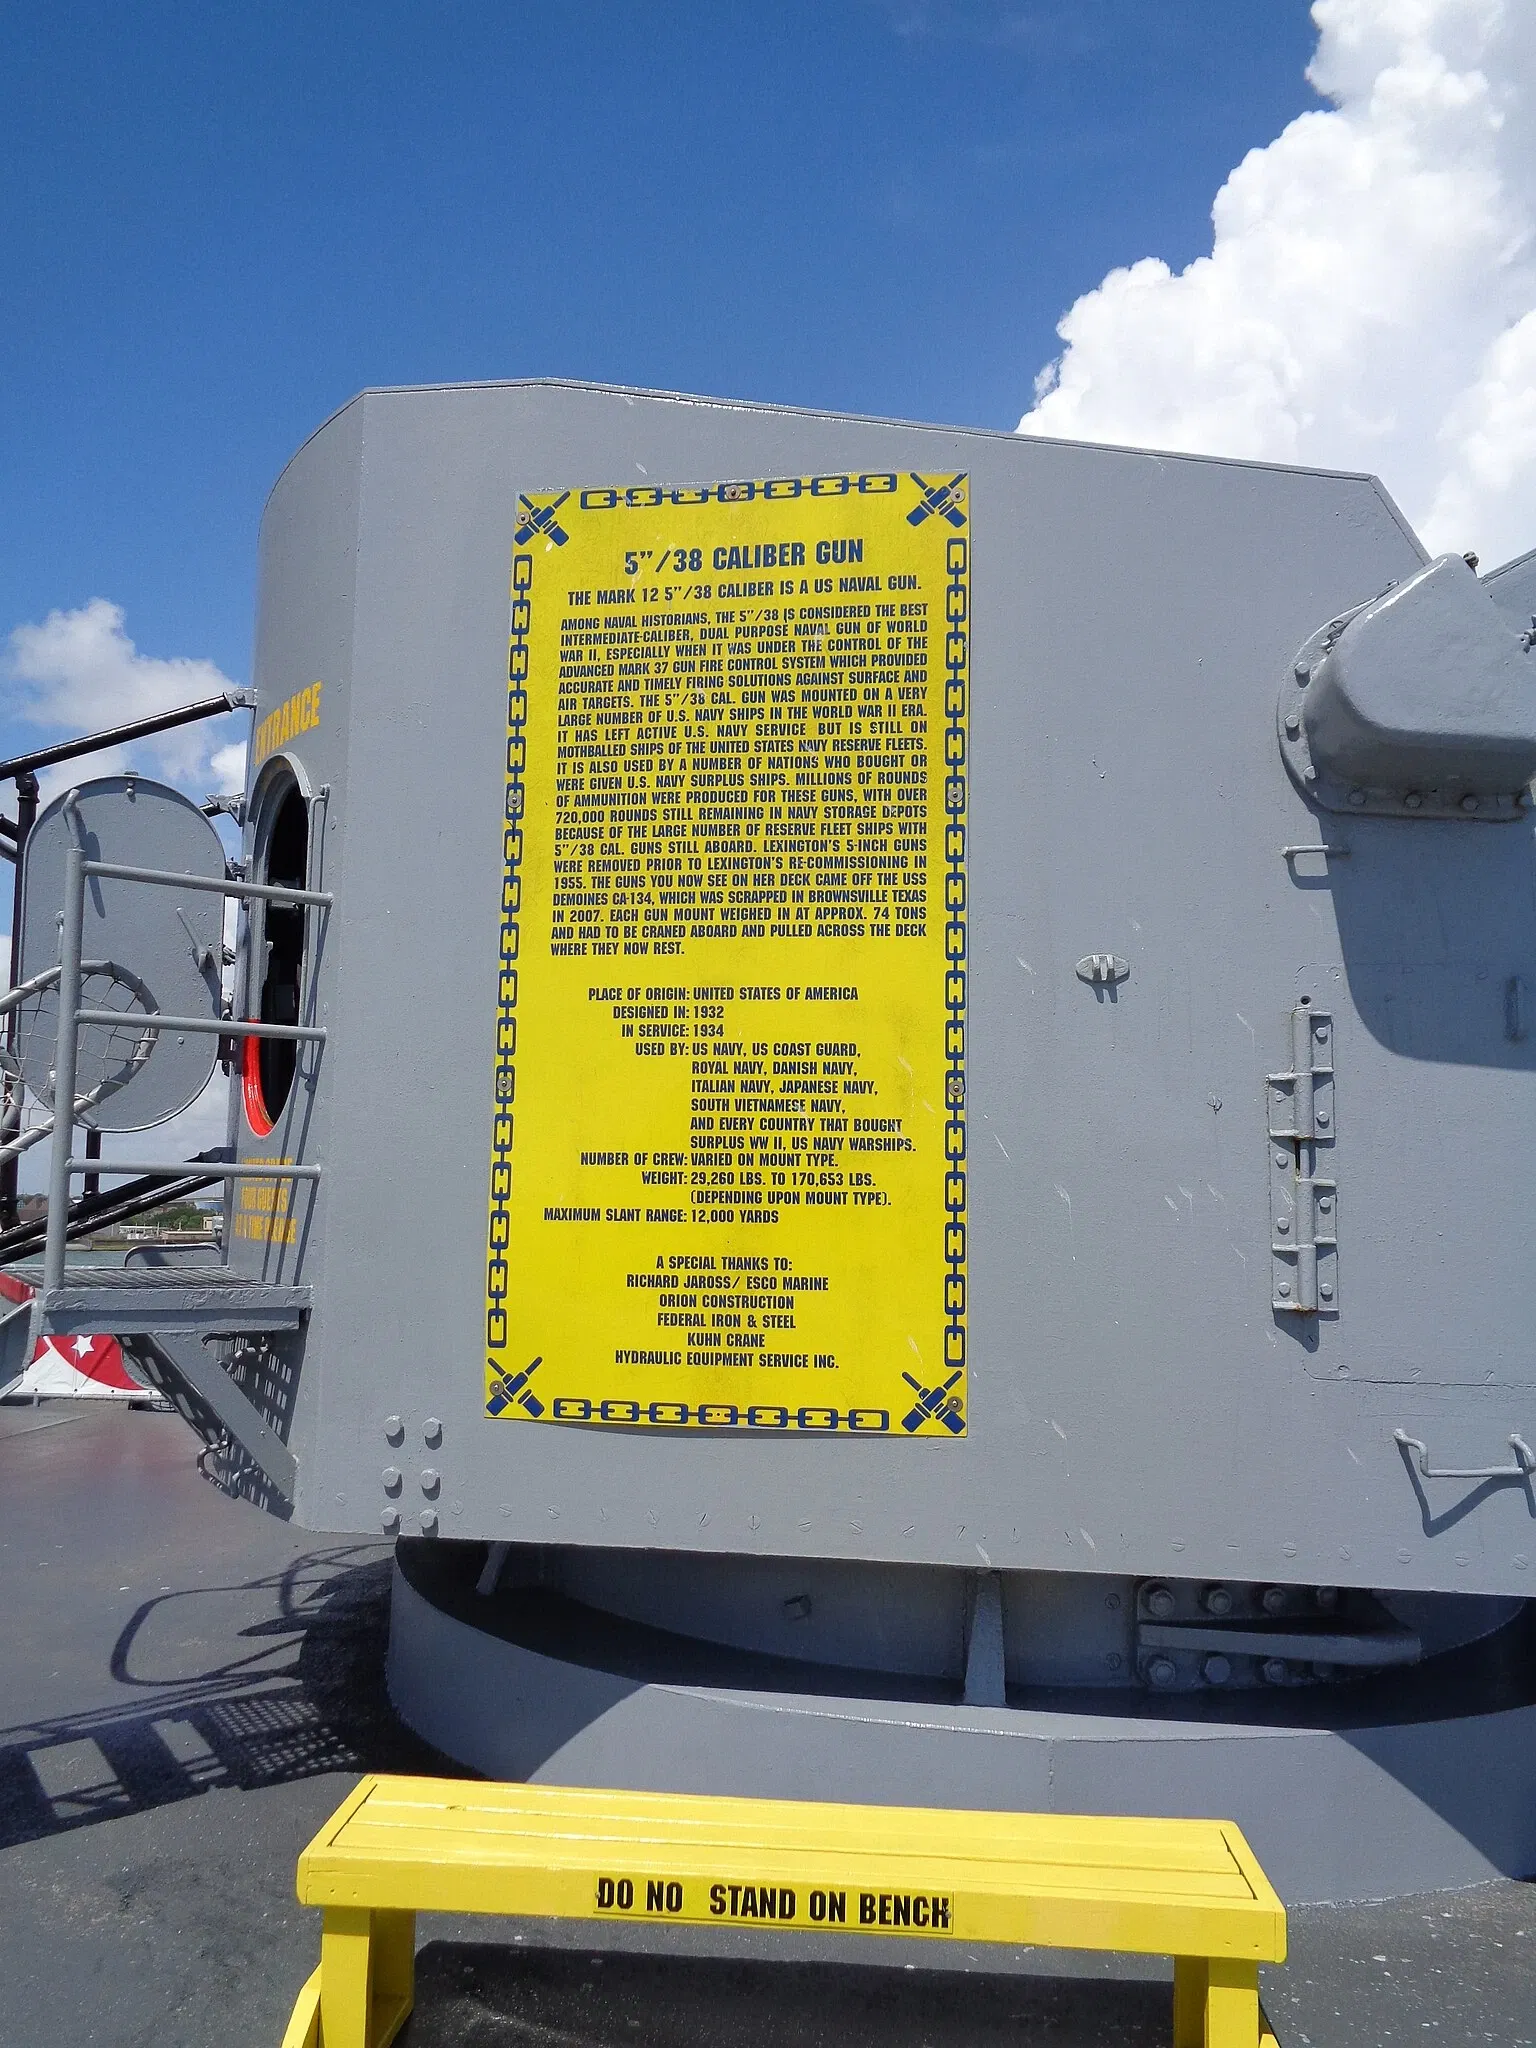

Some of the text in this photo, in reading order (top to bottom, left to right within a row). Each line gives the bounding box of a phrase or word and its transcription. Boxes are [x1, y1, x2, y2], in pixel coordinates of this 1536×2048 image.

[712, 542, 805, 570] CALIBER
[815, 538, 863, 564] GUN
[567, 590, 591, 605] THE
[596, 588, 635, 604] MARK
[642, 587, 658, 602] 12
[717, 581, 773, 598] CALIBER
[779, 579, 793, 595] IS
[799, 579, 808, 594] A
[814, 578, 833, 593] US
[839, 575, 882, 592] NAVAL
[887, 574, 921, 590] GUN.
[560, 619, 927, 645] INTERMEDIATE-CALIBER, DUAL PURPOSE NAVAL GUN OF WORLD
[558, 652, 927, 678] ADVANCED MARK 37 GUN FIRE CONTROL SYSTEM WHICH PROVIDED
[255, 680, 322, 767] ENTRANCE
[555, 770, 927, 791] WERE GIVEN U.S. NAVY SURPLUS SHIPS. MILLIONS OF ROUNDS
[555, 804, 927, 825] 720,000 ROUNDS STILL REMAINING IN NAVY STORAGE DEPOTS
[552, 889, 926, 906] DEMOINES CA-134, WHICH WAS SCRAPPED IN BROWNSVILLE TEXAS
[588, 986, 858, 1000] PLACE OF ORIGIN: UNITED STATES OF AMERICA
[612, 1005, 724, 1019] DESIGNED IN: 1932
[621, 1023, 724, 1037] IN SERVICE: 1934
[635, 1042, 860, 1057] USED BY: US NAVY, US COAST GUARD,
[691, 1060, 857, 1076] ROYAL NAVY, DANISH NAVY,
[691, 1079, 877, 1095] ITALIAN NAVY, JAPANESE NAVY,
[690, 1097, 845, 1114] SOUTH VIETNAMESE NAVY,
[689, 1116, 902, 1132] AND EVERY COUNTRY THAT BOUGHT
[690, 1135, 916, 1151] SURPLUS WW II, US NAVY WARSHIPS.
[580, 1151, 838, 1166] NUMBER OF CREW: VARIED ON MOUNT TYPE.
[641, 1170, 876, 1187] WEIGHT: 29,260 LBS. TO 170,653 LBS.
[690, 1189, 891, 1205] (DEPENDING UPON MOUNT TYPE).
[543, 1207, 778, 1223] MAXIMUM SLANT RANGE: 12,000 YARDS
[655, 1255, 792, 1271] A SPECIAL THANKS TO:
[626, 1273, 678, 1288] RICHARD
[746, 1275, 777, 1289] ESCO
[782, 1276, 828, 1290] MARINE
[659, 1293, 794, 1309] ORION CONSTRUCTION
[657, 1312, 796, 1328] FEDERAL IRON & STEEL
[687, 1332, 765, 1347] KUHN CRANE
[615, 1349, 839, 1368] HYDRAULIC EQUIPMENT SERVICE INC.
[597, 1877, 950, 1929] DO NO STAND ON BENCH
